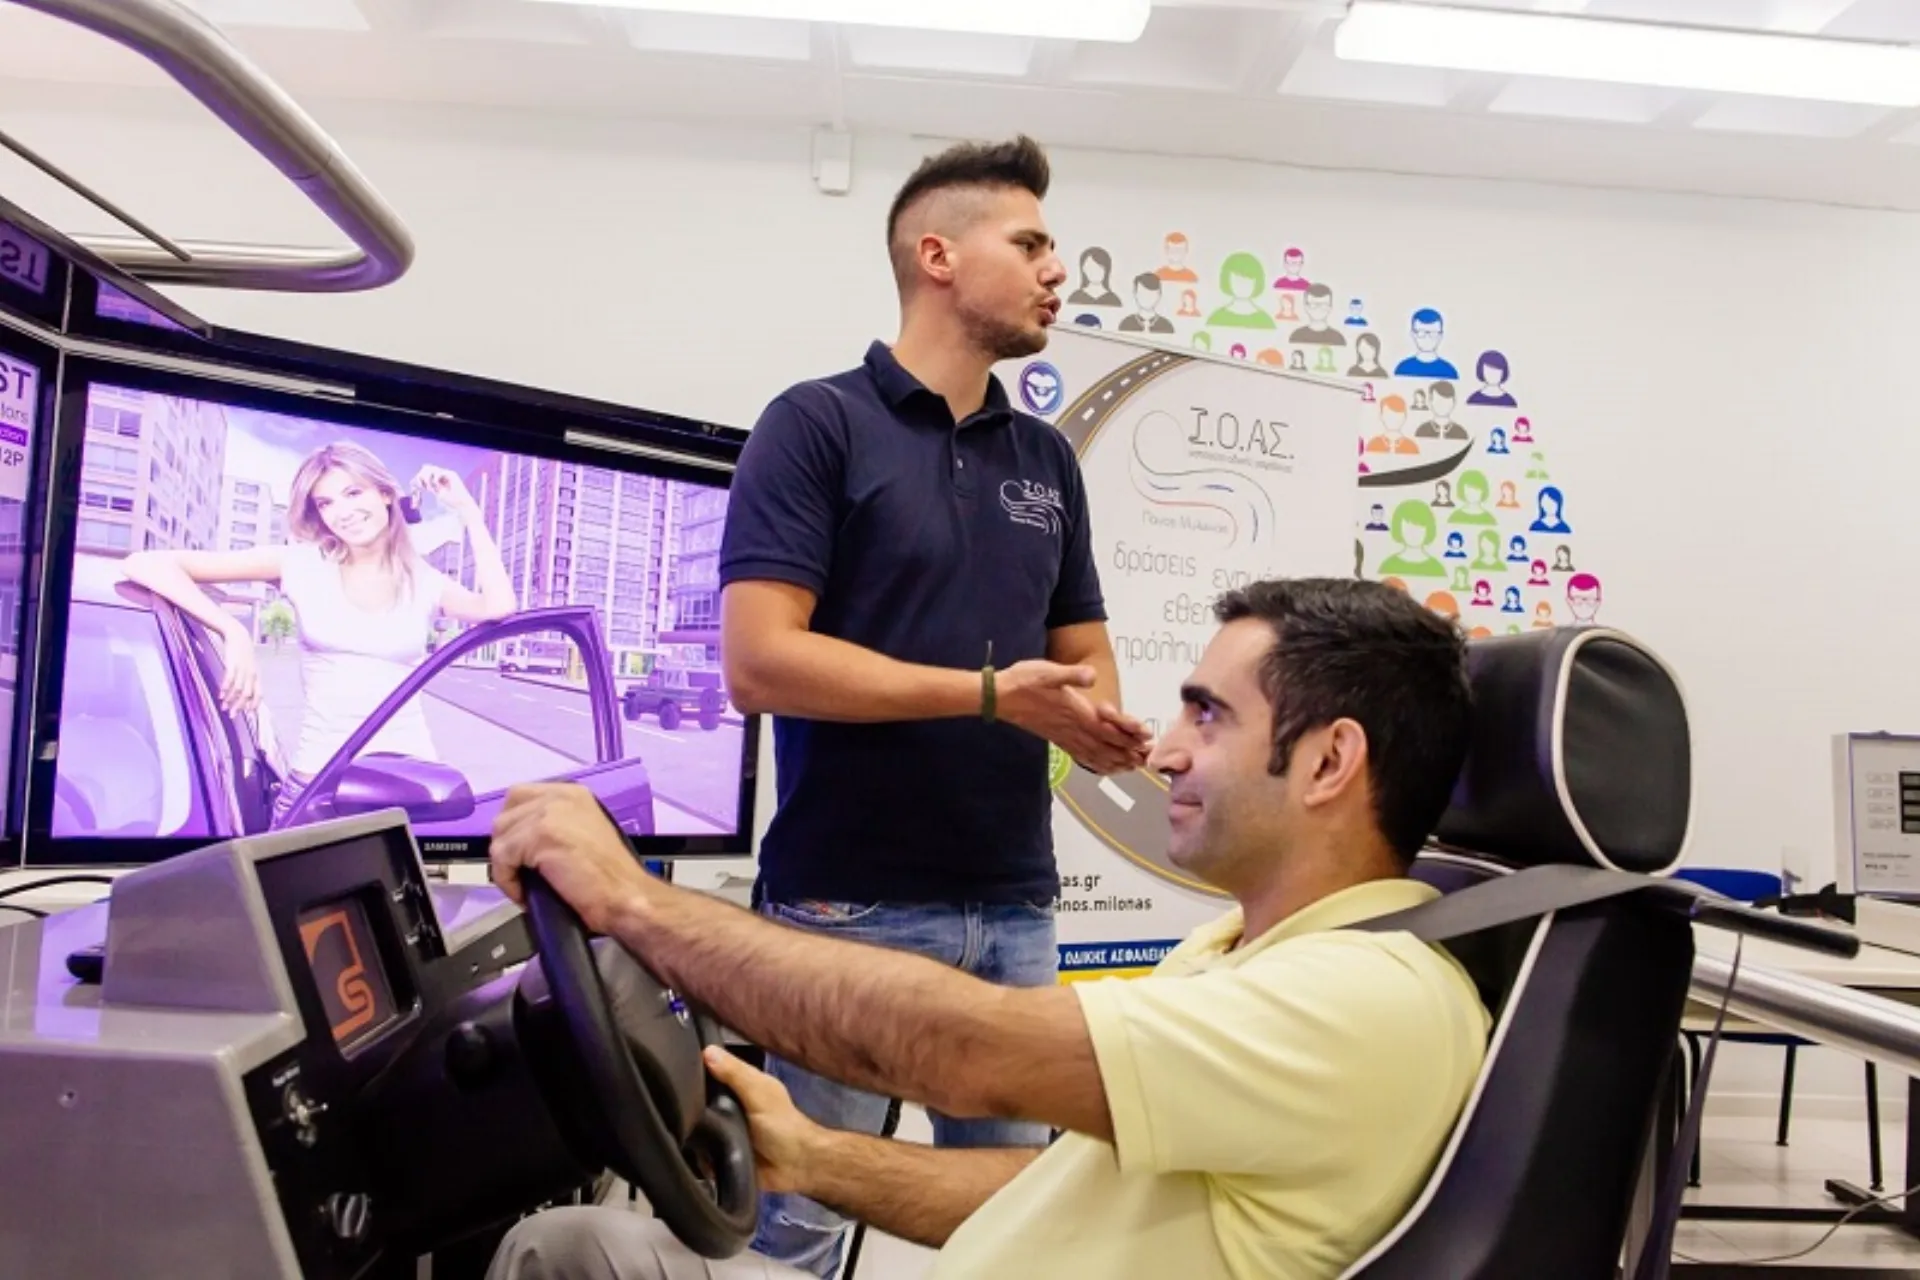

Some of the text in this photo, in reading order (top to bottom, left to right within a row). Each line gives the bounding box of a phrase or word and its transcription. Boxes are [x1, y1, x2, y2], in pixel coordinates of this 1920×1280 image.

[0, 360, 31, 399] ST
[424, 842, 468, 851] SAMSUNG
[1060, 875, 1101, 891] as.gr
[1053, 896, 1152, 912] anos.milonas
